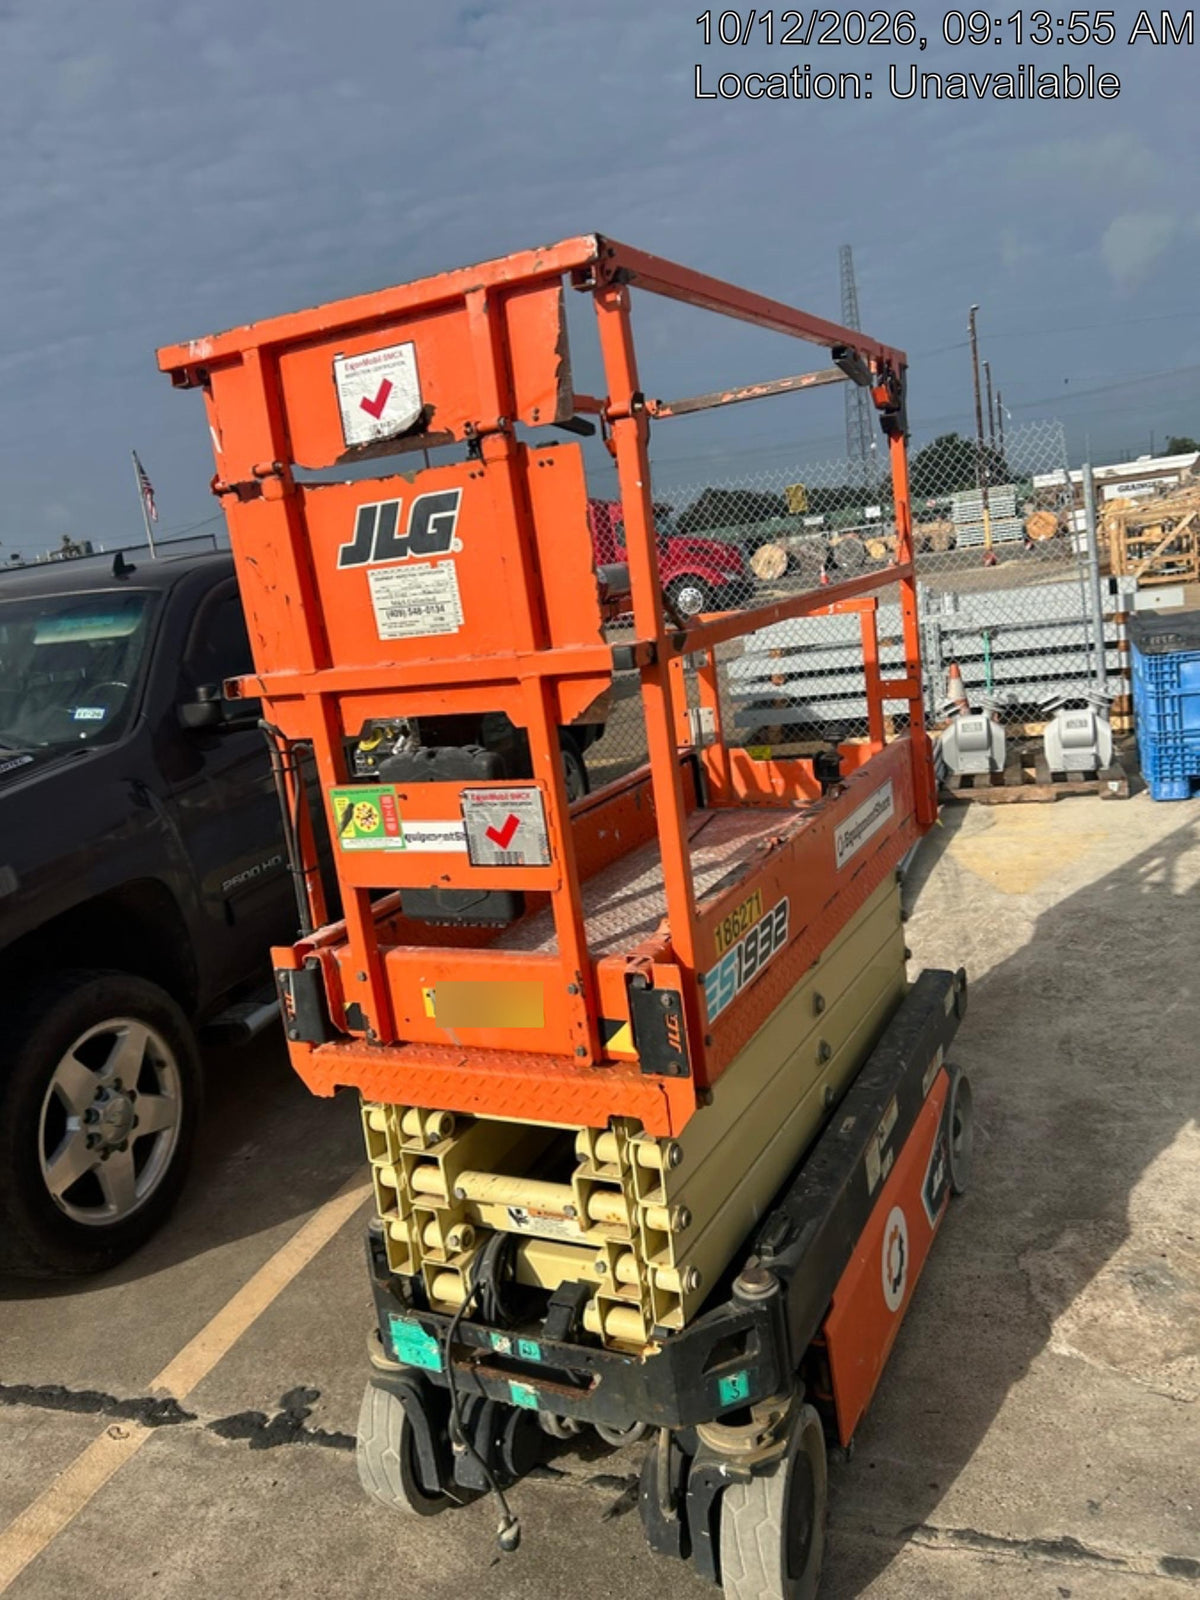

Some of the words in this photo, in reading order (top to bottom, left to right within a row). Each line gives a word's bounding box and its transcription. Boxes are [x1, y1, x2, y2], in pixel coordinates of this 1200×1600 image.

[337, 487, 462, 568] JLG
[715, 894, 763, 953] 186271
[704, 897, 789, 1024] ES1932
[665, 1013, 683, 1055] JLG
